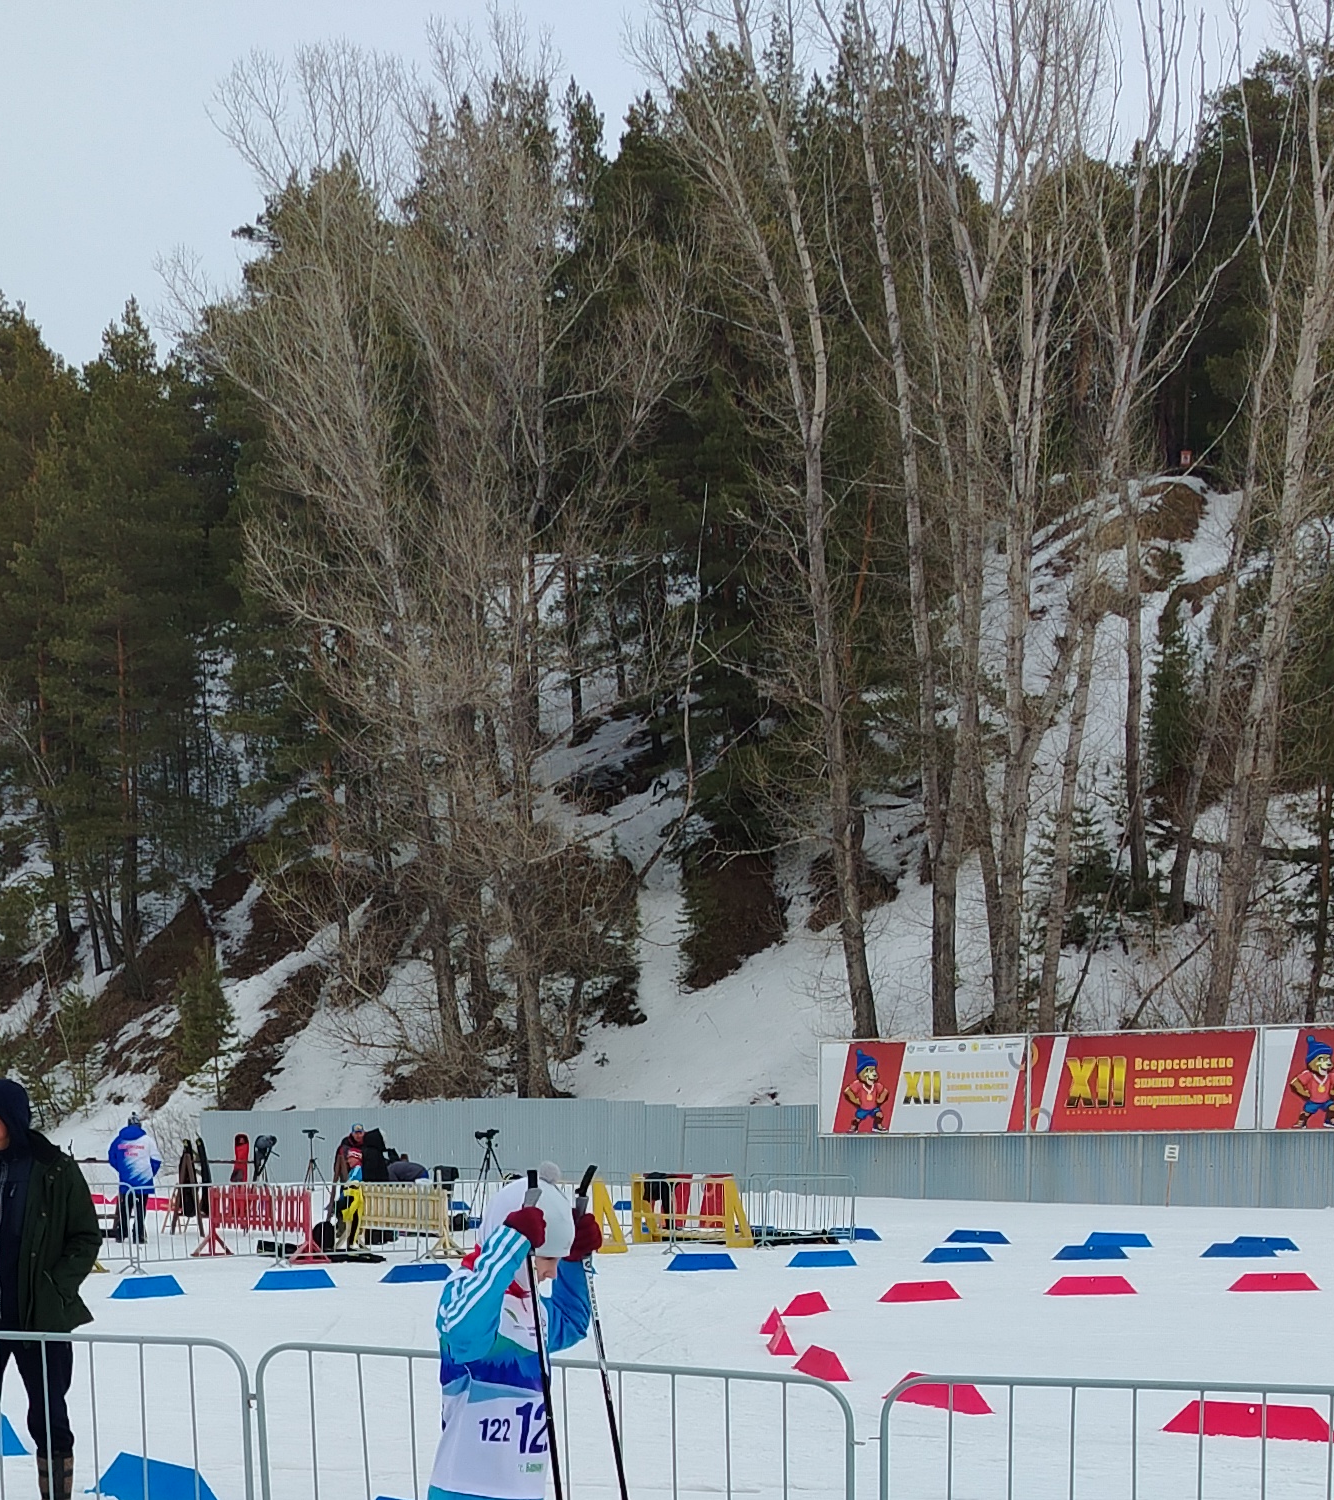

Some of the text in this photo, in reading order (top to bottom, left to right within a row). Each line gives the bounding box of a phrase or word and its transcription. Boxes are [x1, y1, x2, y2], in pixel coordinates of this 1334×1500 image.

[1134, 1056, 1234, 1073] Всероссийские
[903, 1071, 941, 1105] XII
[1064, 1055, 1127, 1108] XII
[1134, 1075, 1233, 1088] зимние сельские
[1133, 1094, 1233, 1108] спортивные игры
[479, 1418, 511, 1442] 122
[515, 1401, 548, 1454] 12
